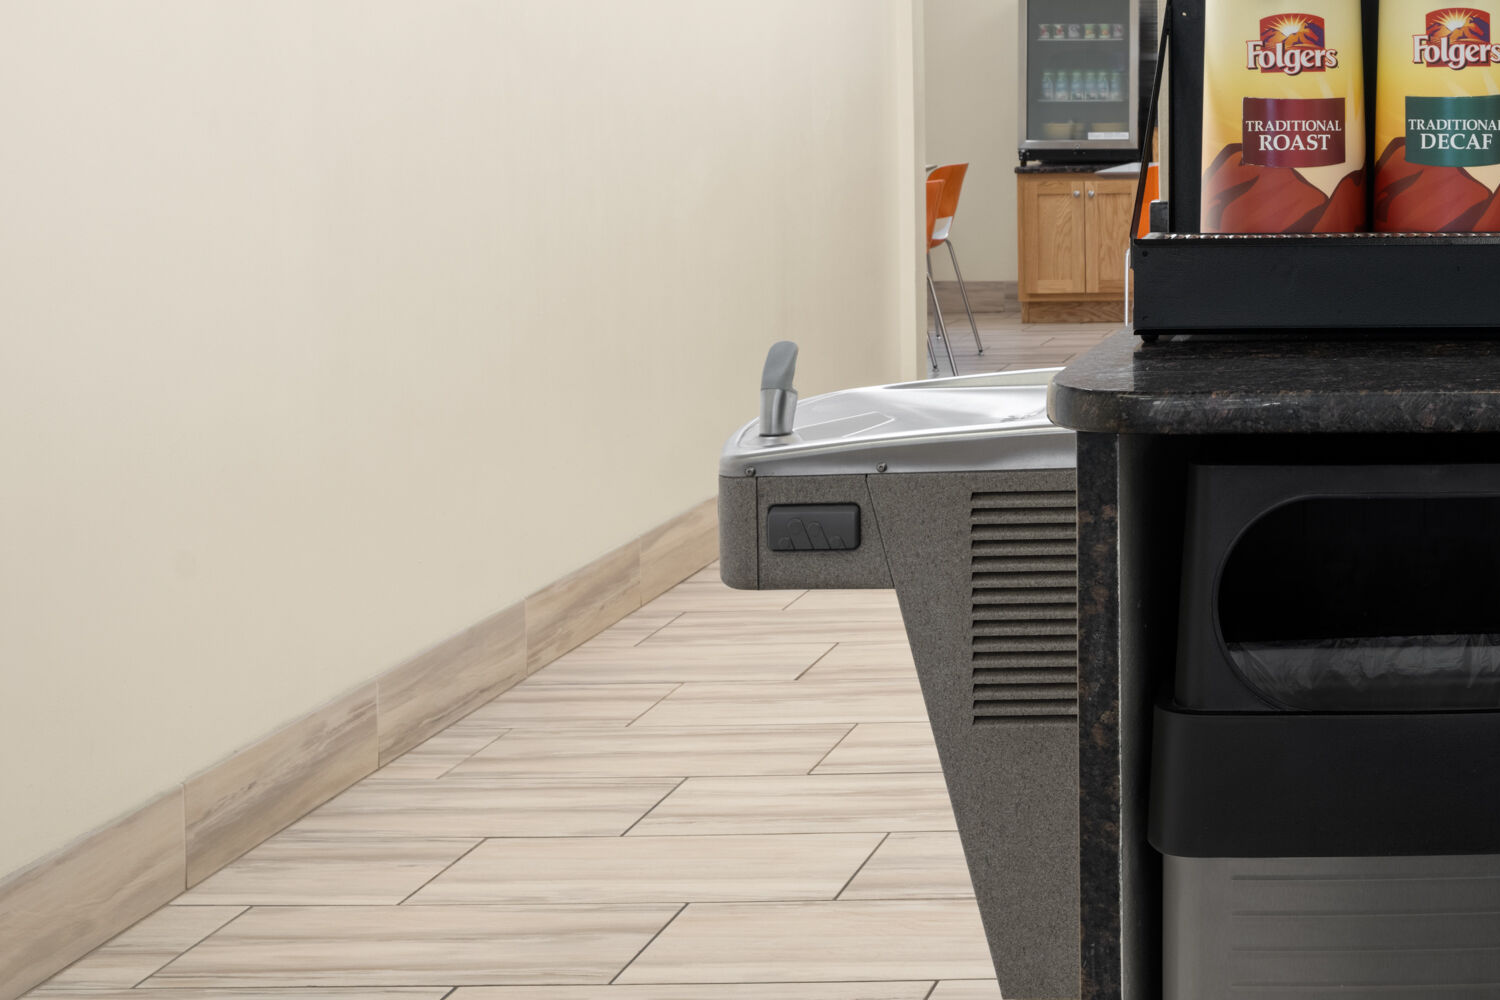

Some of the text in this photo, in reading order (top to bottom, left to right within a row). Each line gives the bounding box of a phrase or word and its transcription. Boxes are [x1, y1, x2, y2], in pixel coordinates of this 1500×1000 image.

[1246, 39, 1339, 75] Folgers
[1245, 119, 1342, 132] TRADITIONAL
[1258, 134, 1331, 151] ROAST
[1420, 133, 1493, 150] DECAF
